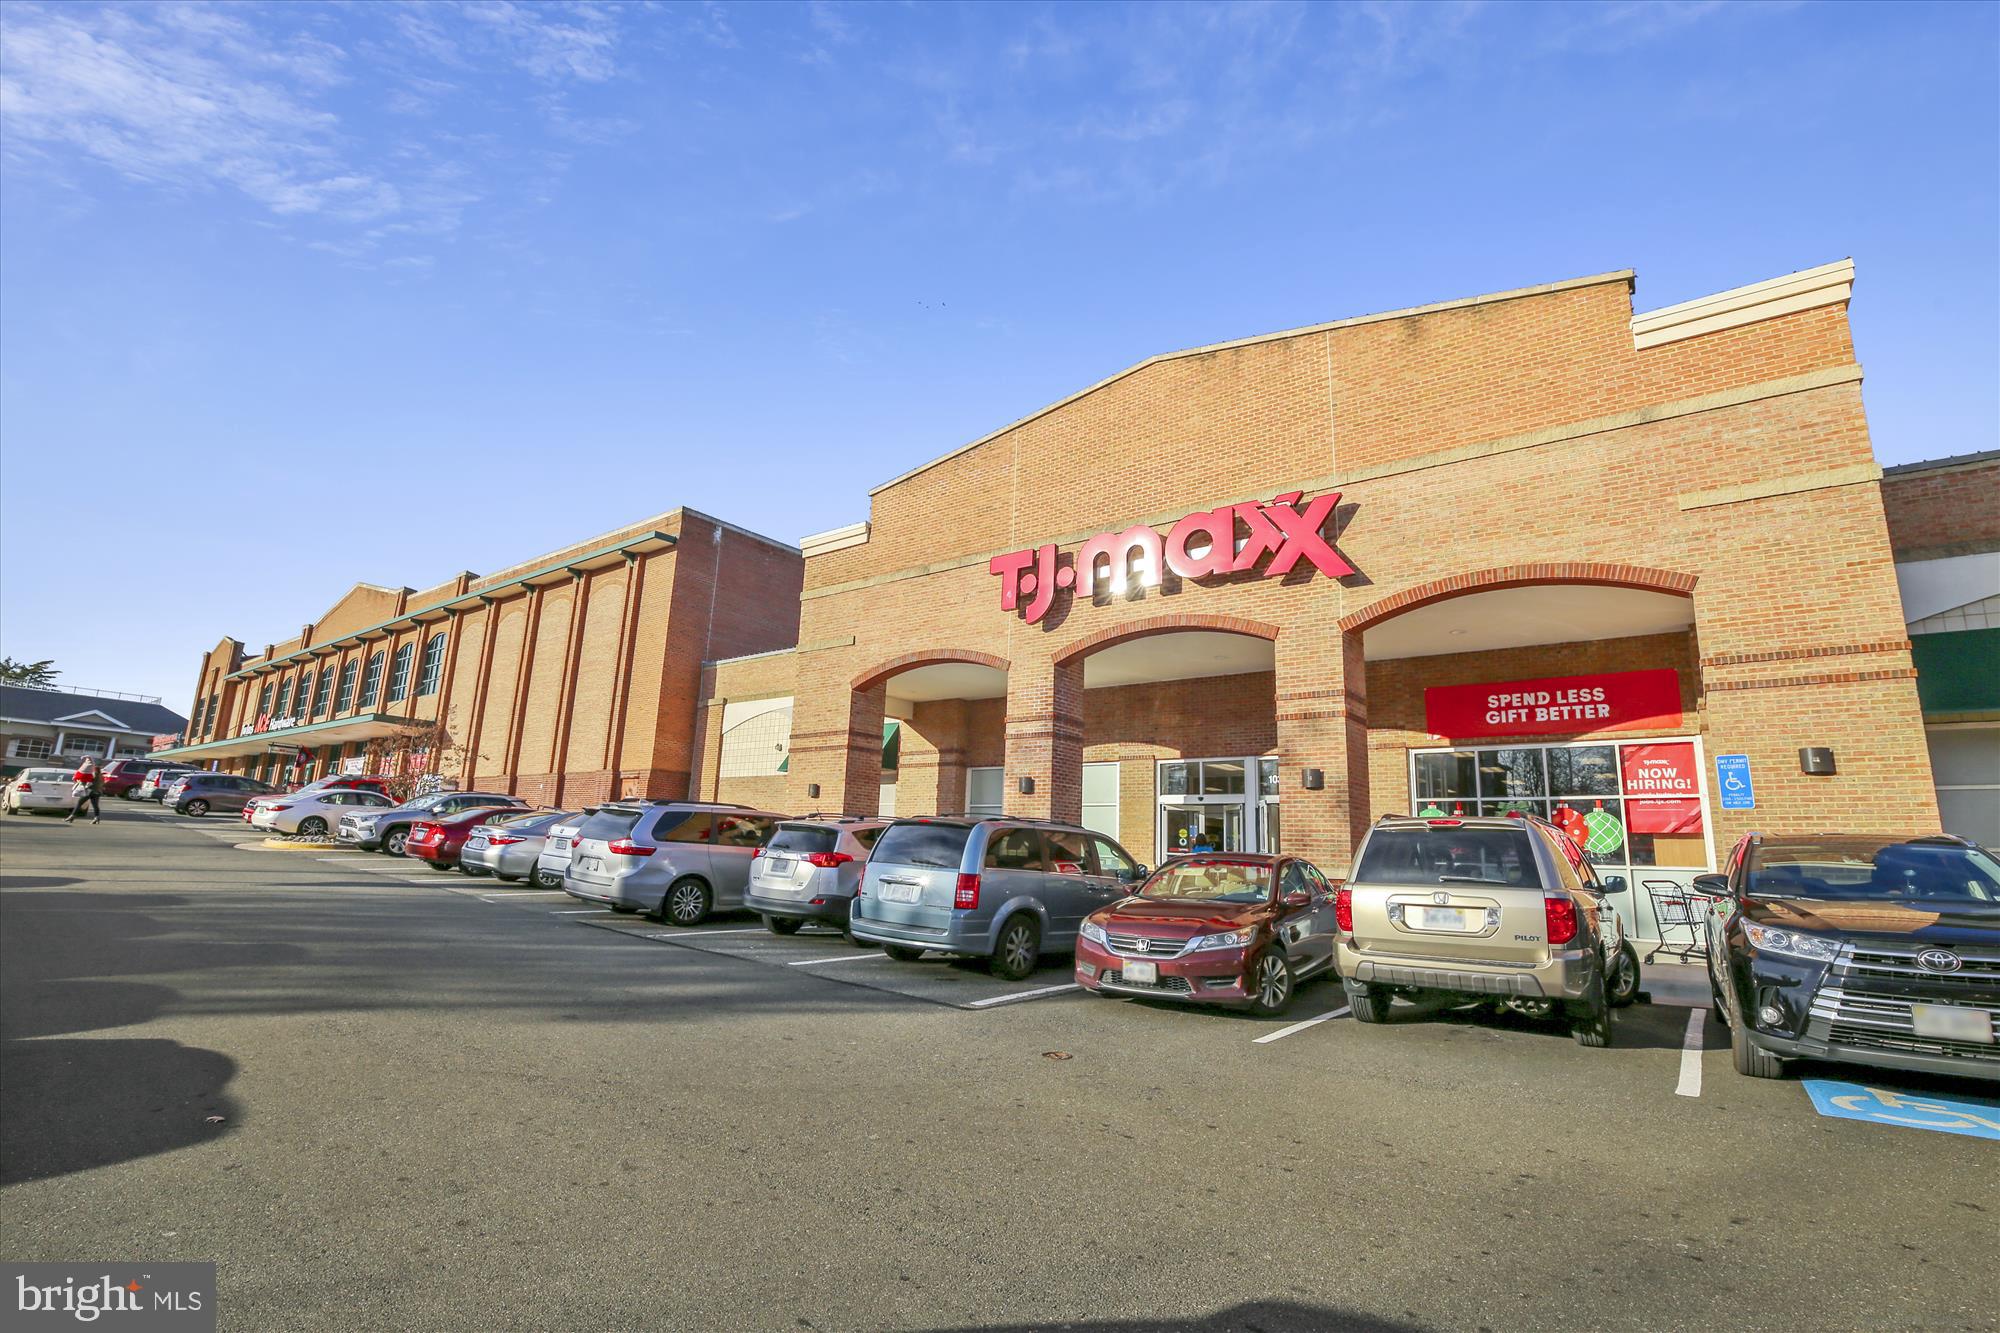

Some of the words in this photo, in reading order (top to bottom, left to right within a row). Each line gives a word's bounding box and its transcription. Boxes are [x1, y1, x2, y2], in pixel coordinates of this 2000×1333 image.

[1487, 691, 1550, 709] SPEND
[1556, 687, 1606, 704] LESS
[1485, 708, 1534, 725] GIFT
[1535, 703, 1611, 723] BETTER
[1638, 767, 1678, 779] NOW
[1626, 778, 1692, 790] HIRING!
[1513, 934, 1542, 942] PILOT
